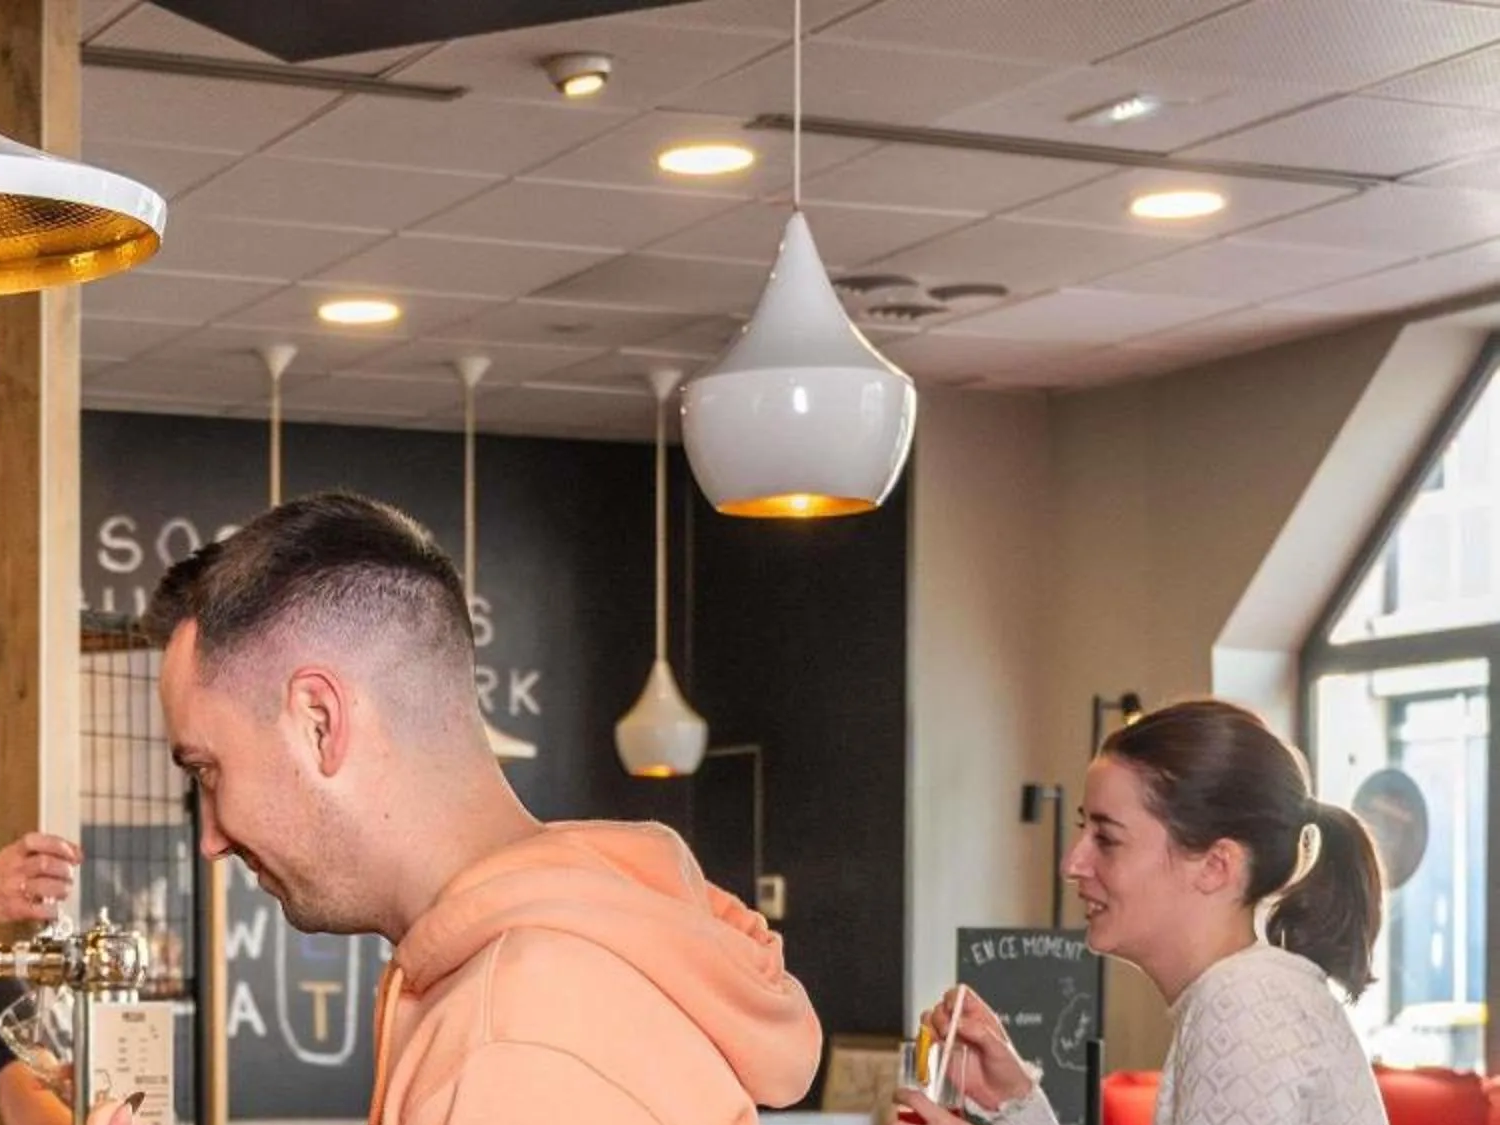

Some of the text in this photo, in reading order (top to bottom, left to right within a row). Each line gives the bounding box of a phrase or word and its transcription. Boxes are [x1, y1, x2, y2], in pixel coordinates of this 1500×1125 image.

[98, 514, 245, 573] SO
[475, 665, 542, 716] RK
[970, 934, 1086, 967] EN CE MOMENT
[227, 980, 343, 1042] A T
